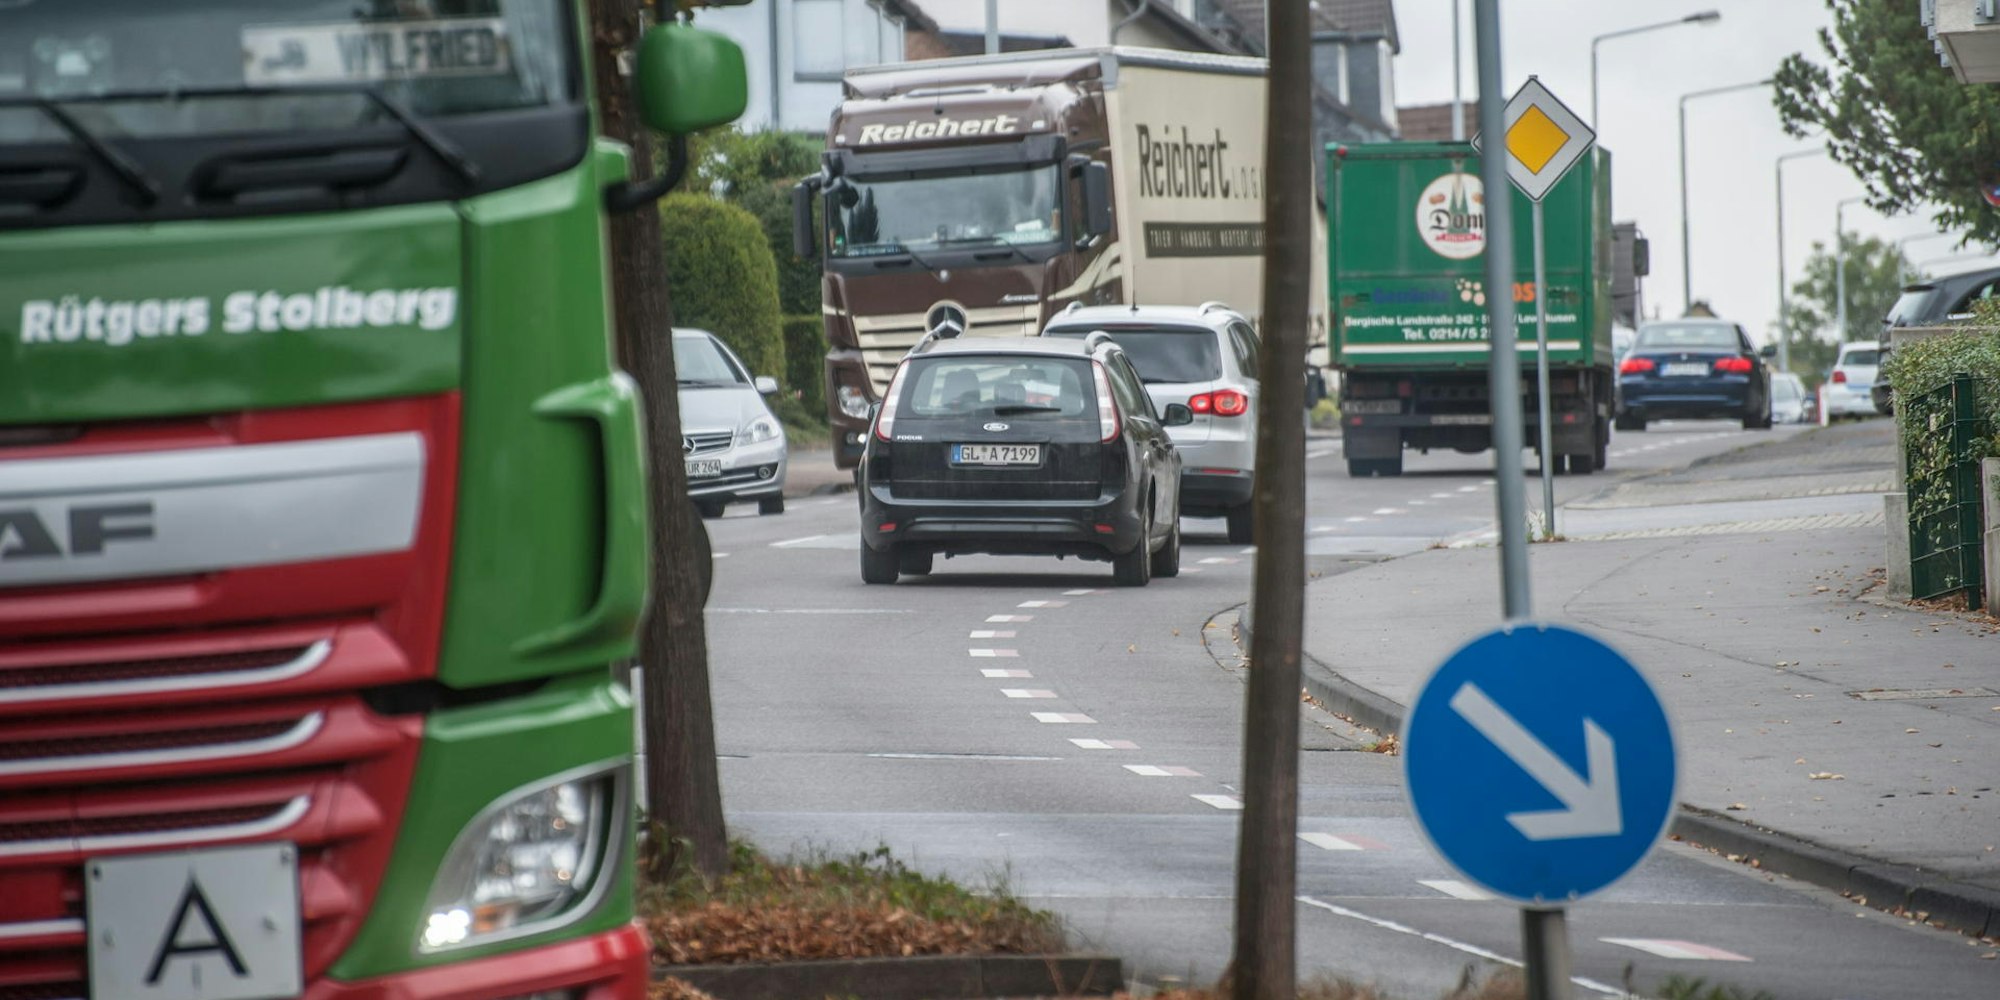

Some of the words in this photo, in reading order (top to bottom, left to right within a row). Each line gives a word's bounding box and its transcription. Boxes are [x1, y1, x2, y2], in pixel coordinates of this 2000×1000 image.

[858, 114, 1018, 145] Reichert
[1136, 123, 1229, 199] Reichert
[1429, 208, 1483, 230] Dom
[20, 295, 209, 346] Rütgers
[222, 286, 457, 331] Stolberg
[1344, 316, 1394, 328] Bergische
[1397, 314, 1453, 326] Landstraße
[1402, 328, 1425, 340] Tel.
[961, 446, 979, 460] GL
[989, 447, 998, 460] A
[1001, 447, 1037, 461] 7199
[144, 868, 250, 986] A
